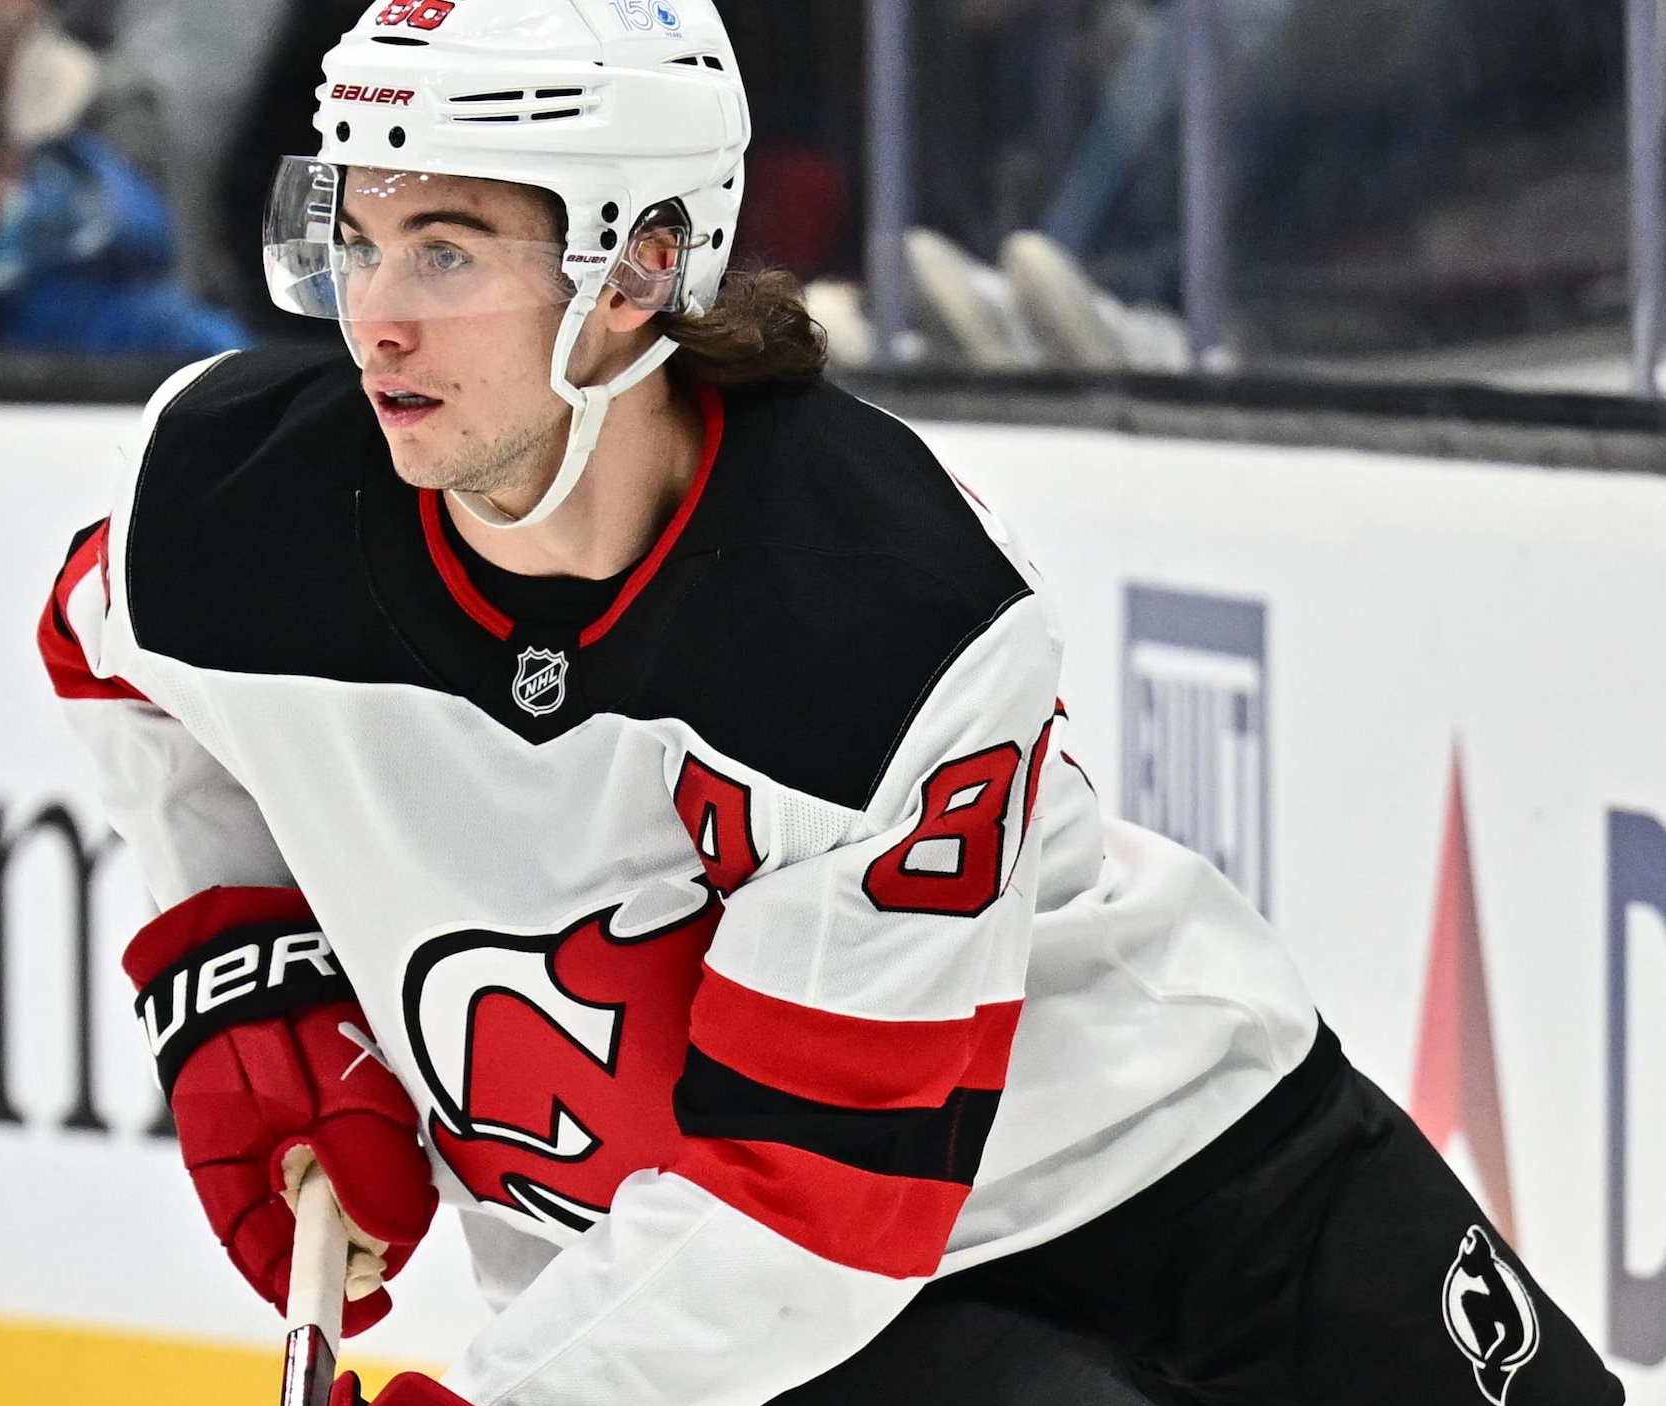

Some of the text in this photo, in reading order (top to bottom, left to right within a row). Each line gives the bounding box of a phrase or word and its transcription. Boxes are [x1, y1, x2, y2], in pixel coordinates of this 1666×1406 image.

[330, 84, 415, 106] BAUER
[566, 254, 608, 264] BAUER
[524, 667, 558, 699] NHL
[674, 751, 770, 898] A
[136, 930, 337, 1058] UER
